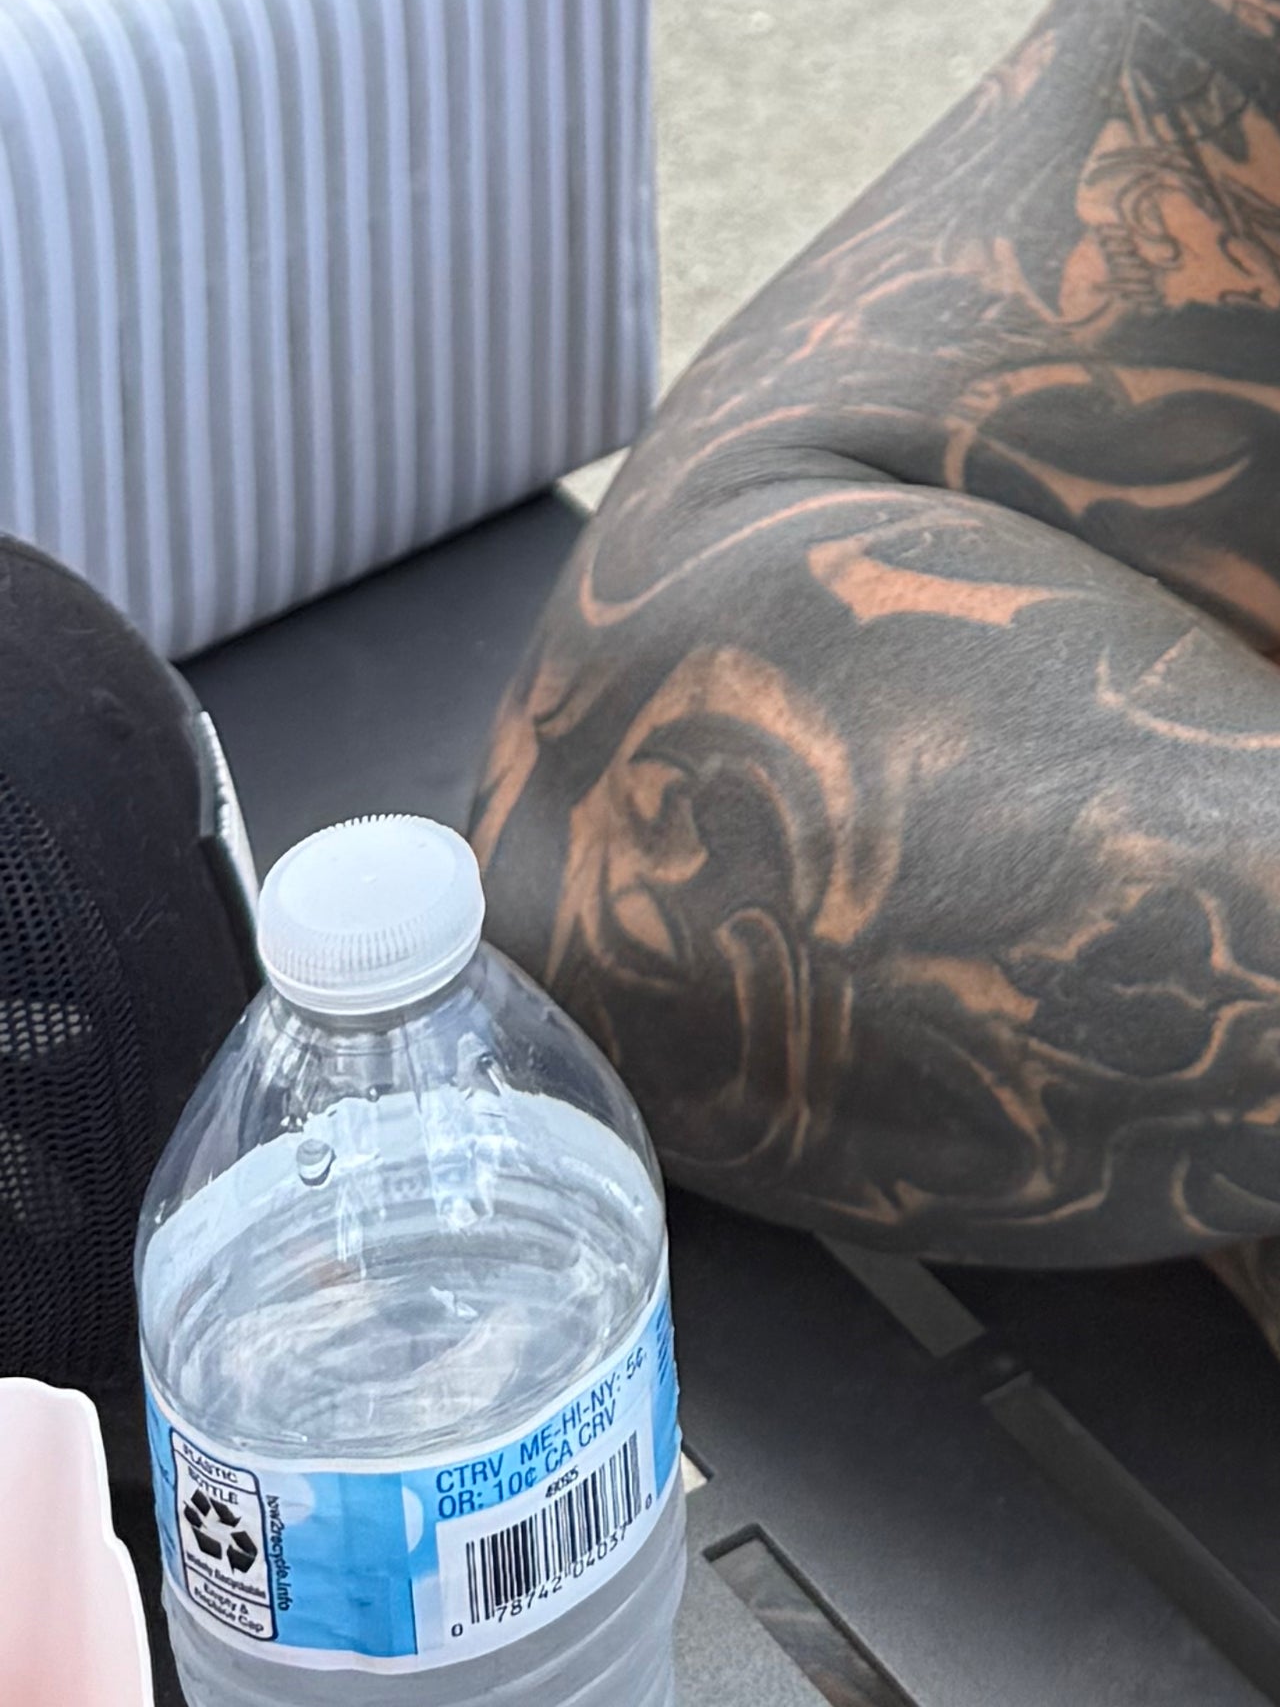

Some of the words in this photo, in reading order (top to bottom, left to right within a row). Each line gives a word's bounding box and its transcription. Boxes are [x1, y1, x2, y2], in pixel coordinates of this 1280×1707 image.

[436, 1453, 504, 1494] CTRV
[520, 1373, 622, 1465] ME-HI-NY:
[438, 1488, 484, 1519] OR:
[497, 1467, 538, 1504] 10¢
[545, 1444, 573, 1474] CA
[579, 1400, 616, 1448] CRV
[188, 1466, 238, 1505] BOTTLE
[451, 1623, 464, 1637] 0
